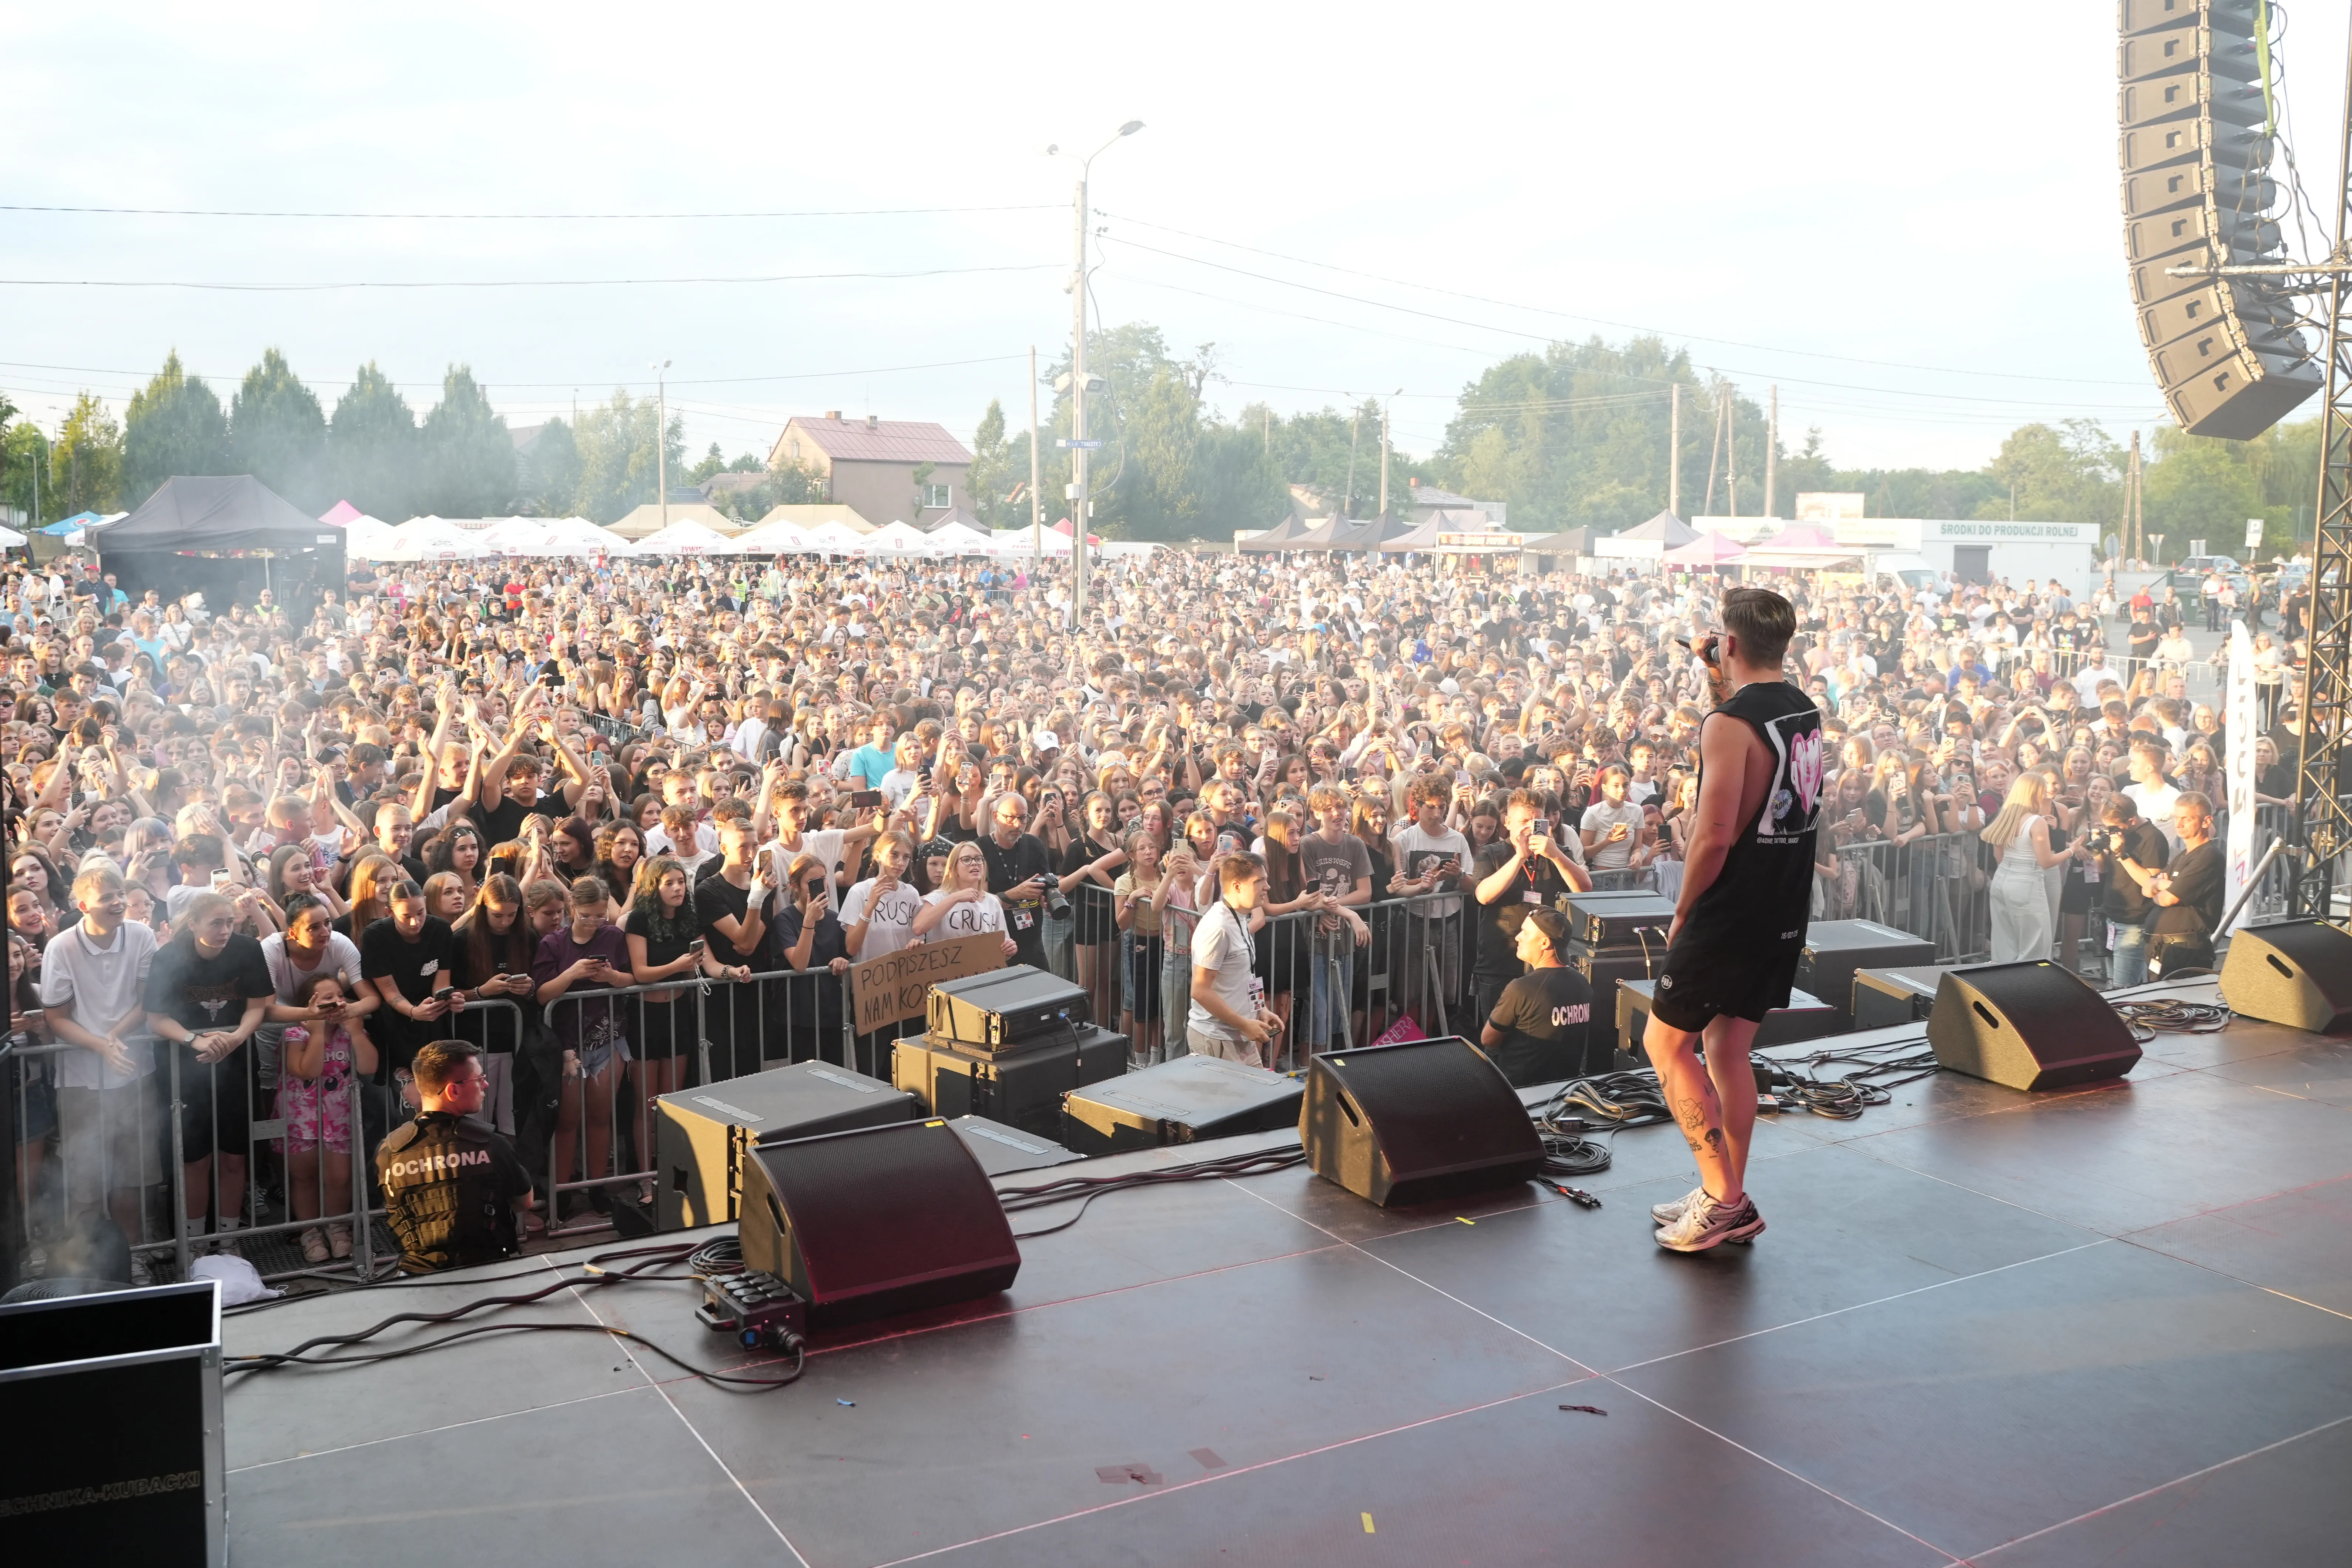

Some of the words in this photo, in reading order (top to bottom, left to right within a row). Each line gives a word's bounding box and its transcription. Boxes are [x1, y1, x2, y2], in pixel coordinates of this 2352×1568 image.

[1941, 522, 1976, 535] ŚRODKI
[1979, 525, 1991, 535] DO
[1994, 525, 2043, 536] PRODUKCJI
[2046, 526, 2078, 537] ROLNEJ
[2249, 521, 2261, 533] P
[1775, 798, 1789, 810] ADHD
[865, 899, 917, 927] RUSH
[865, 991, 892, 1026] NAM
[392, 1150, 491, 1177] OCHRONA
